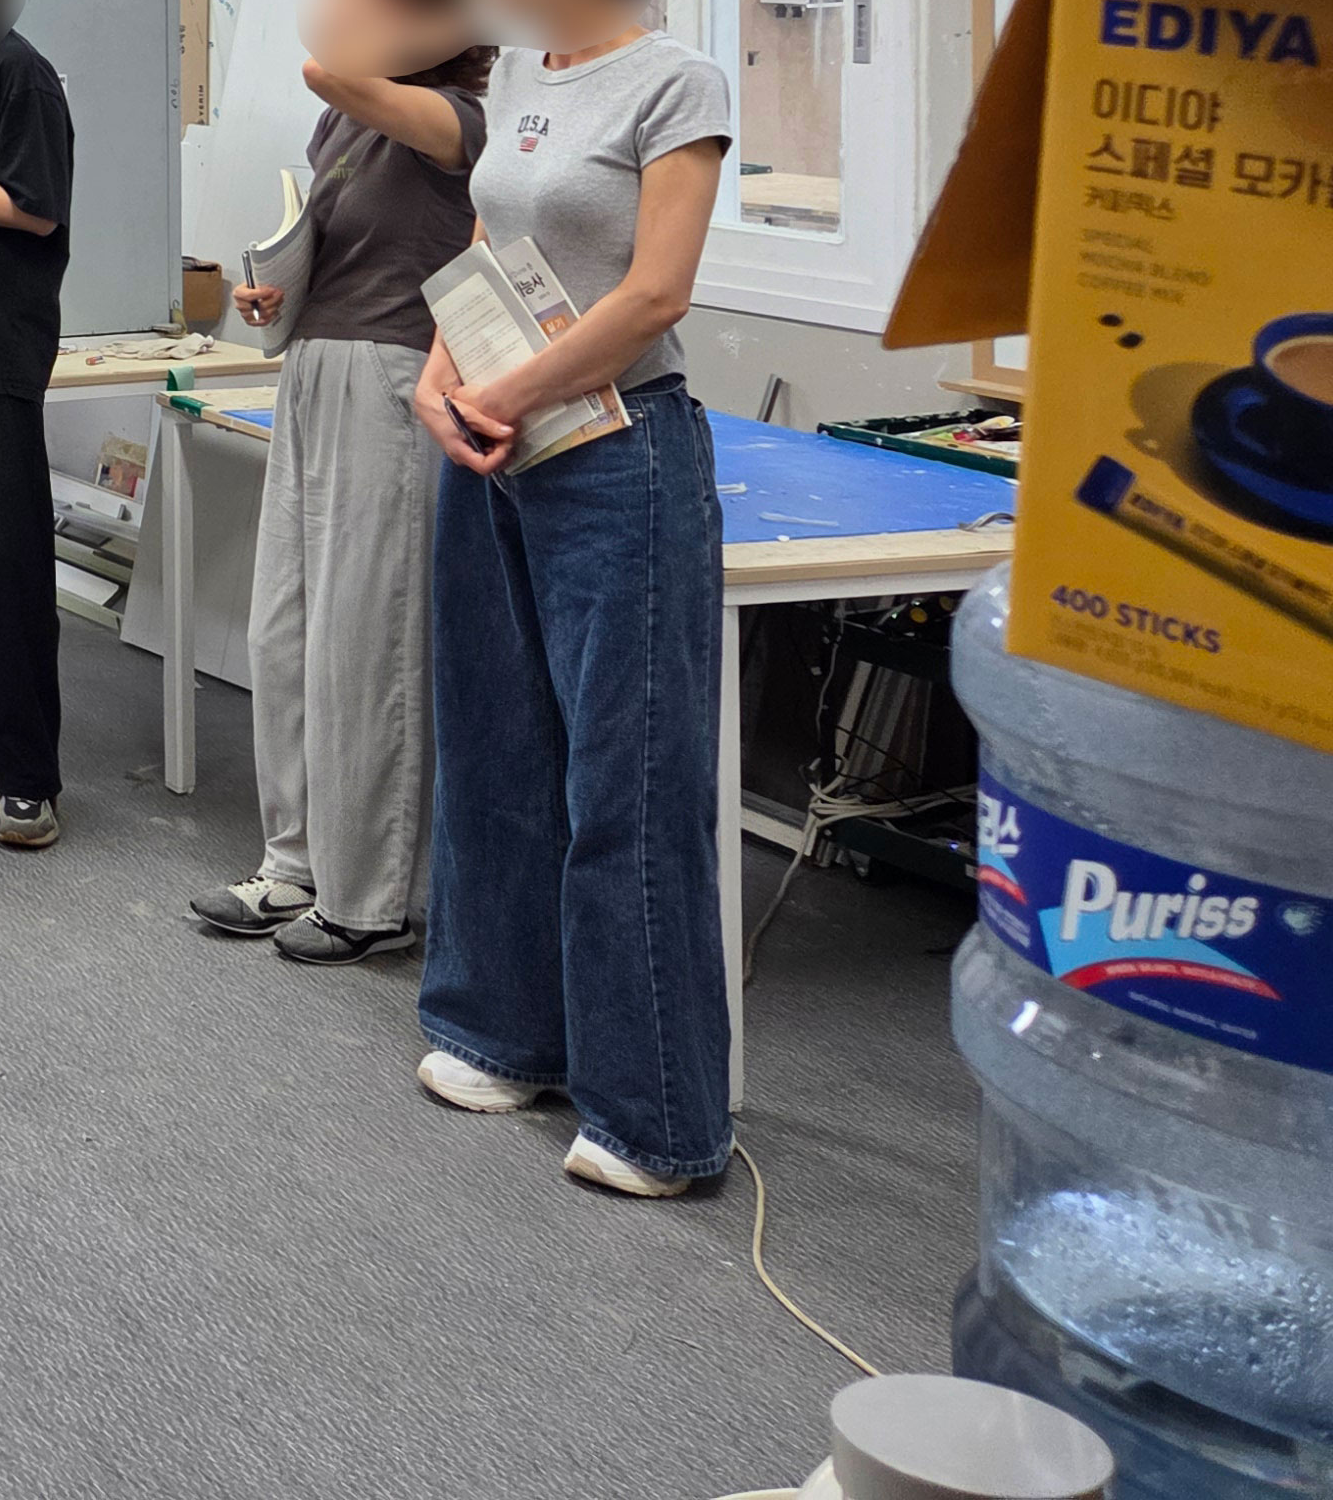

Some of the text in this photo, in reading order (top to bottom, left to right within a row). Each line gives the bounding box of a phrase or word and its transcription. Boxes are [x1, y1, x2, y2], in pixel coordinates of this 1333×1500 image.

[1092, 77, 1222, 133] 이디야
[1084, 133, 1214, 190] 스페셜
[1050, 585, 1221, 654] 400 STICKS
[1059, 859, 1259, 941] Puriss
